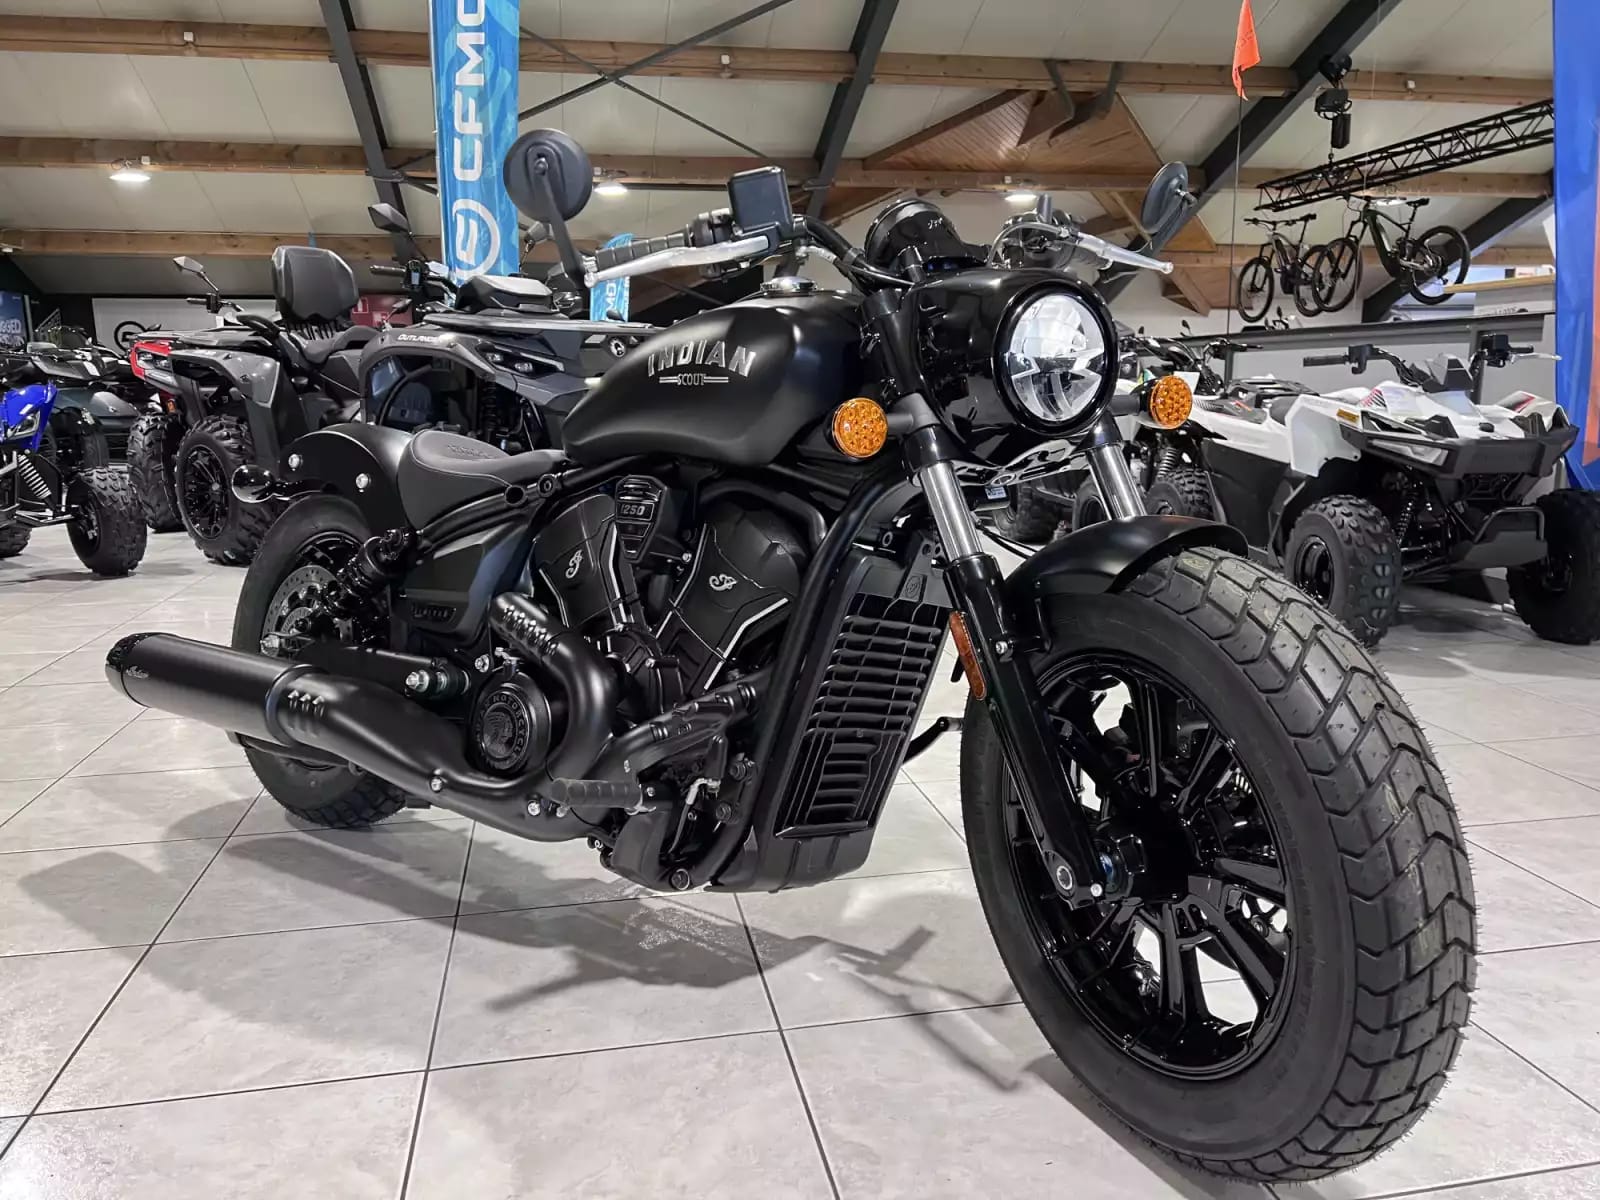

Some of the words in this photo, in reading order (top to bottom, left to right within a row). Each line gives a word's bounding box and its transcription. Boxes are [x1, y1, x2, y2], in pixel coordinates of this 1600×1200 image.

[648, 339, 757, 377] INDIAN
[677, 373, 706, 386] SCOUT
[621, 504, 646, 516] 1250
